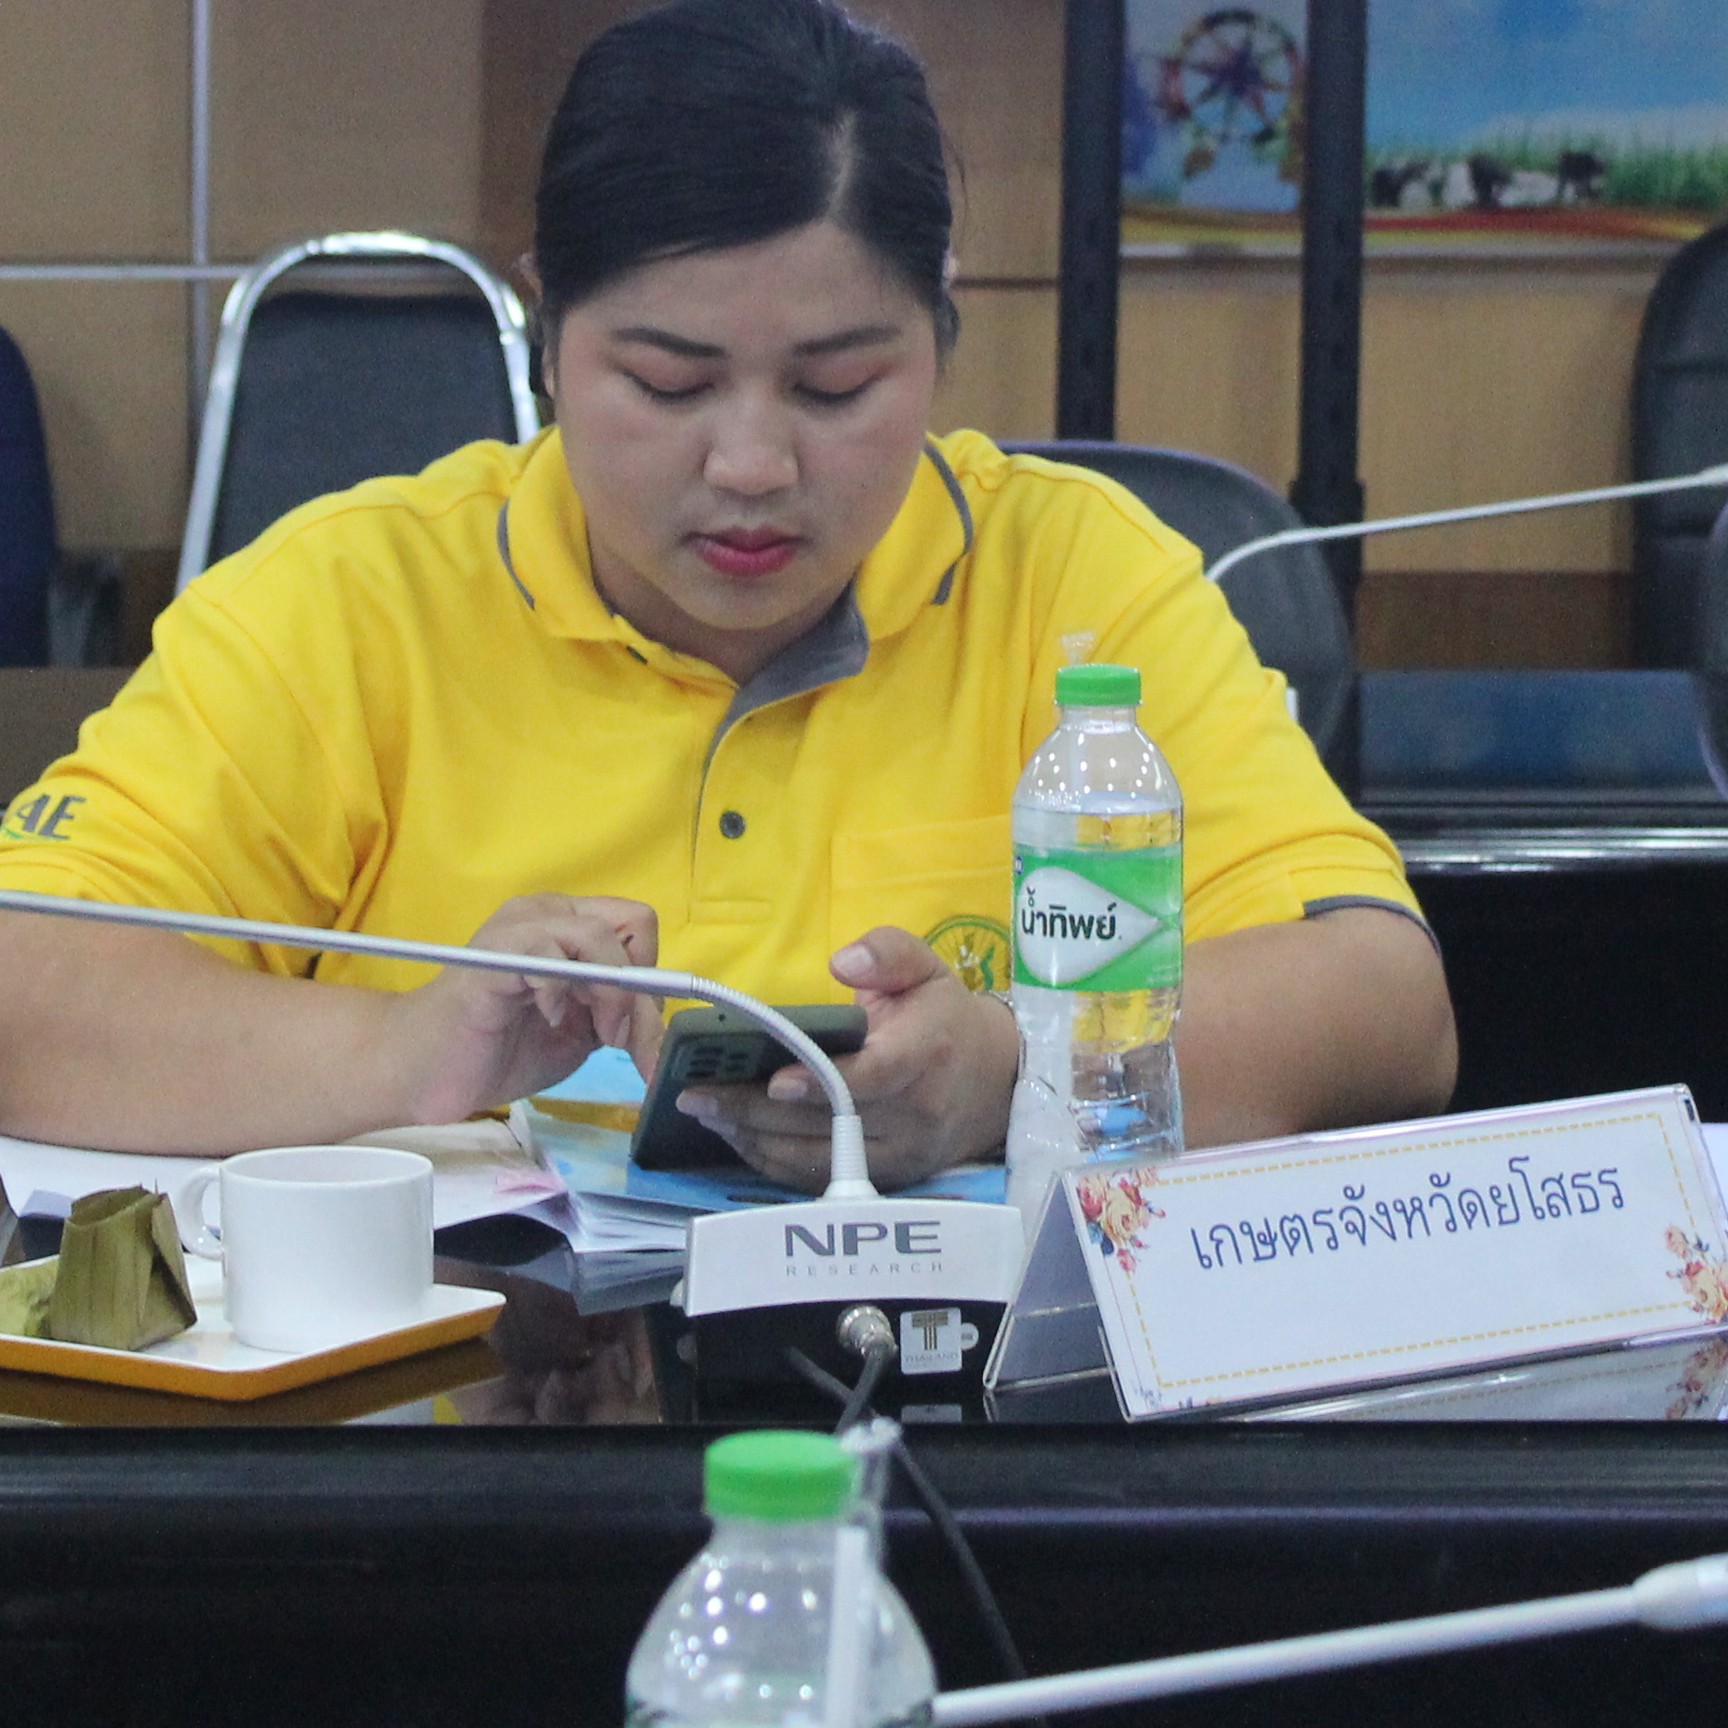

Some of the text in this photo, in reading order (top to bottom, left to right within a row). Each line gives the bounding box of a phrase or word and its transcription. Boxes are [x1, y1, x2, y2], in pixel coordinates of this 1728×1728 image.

[1021, 885, 1117, 941] น้ำทิพย์
[1190, 1155, 1626, 1271] เกษตรจังหวัดยโสธร
[784, 1220, 943, 1257] NPE
[785, 1262, 943, 1277] RESEARCH
